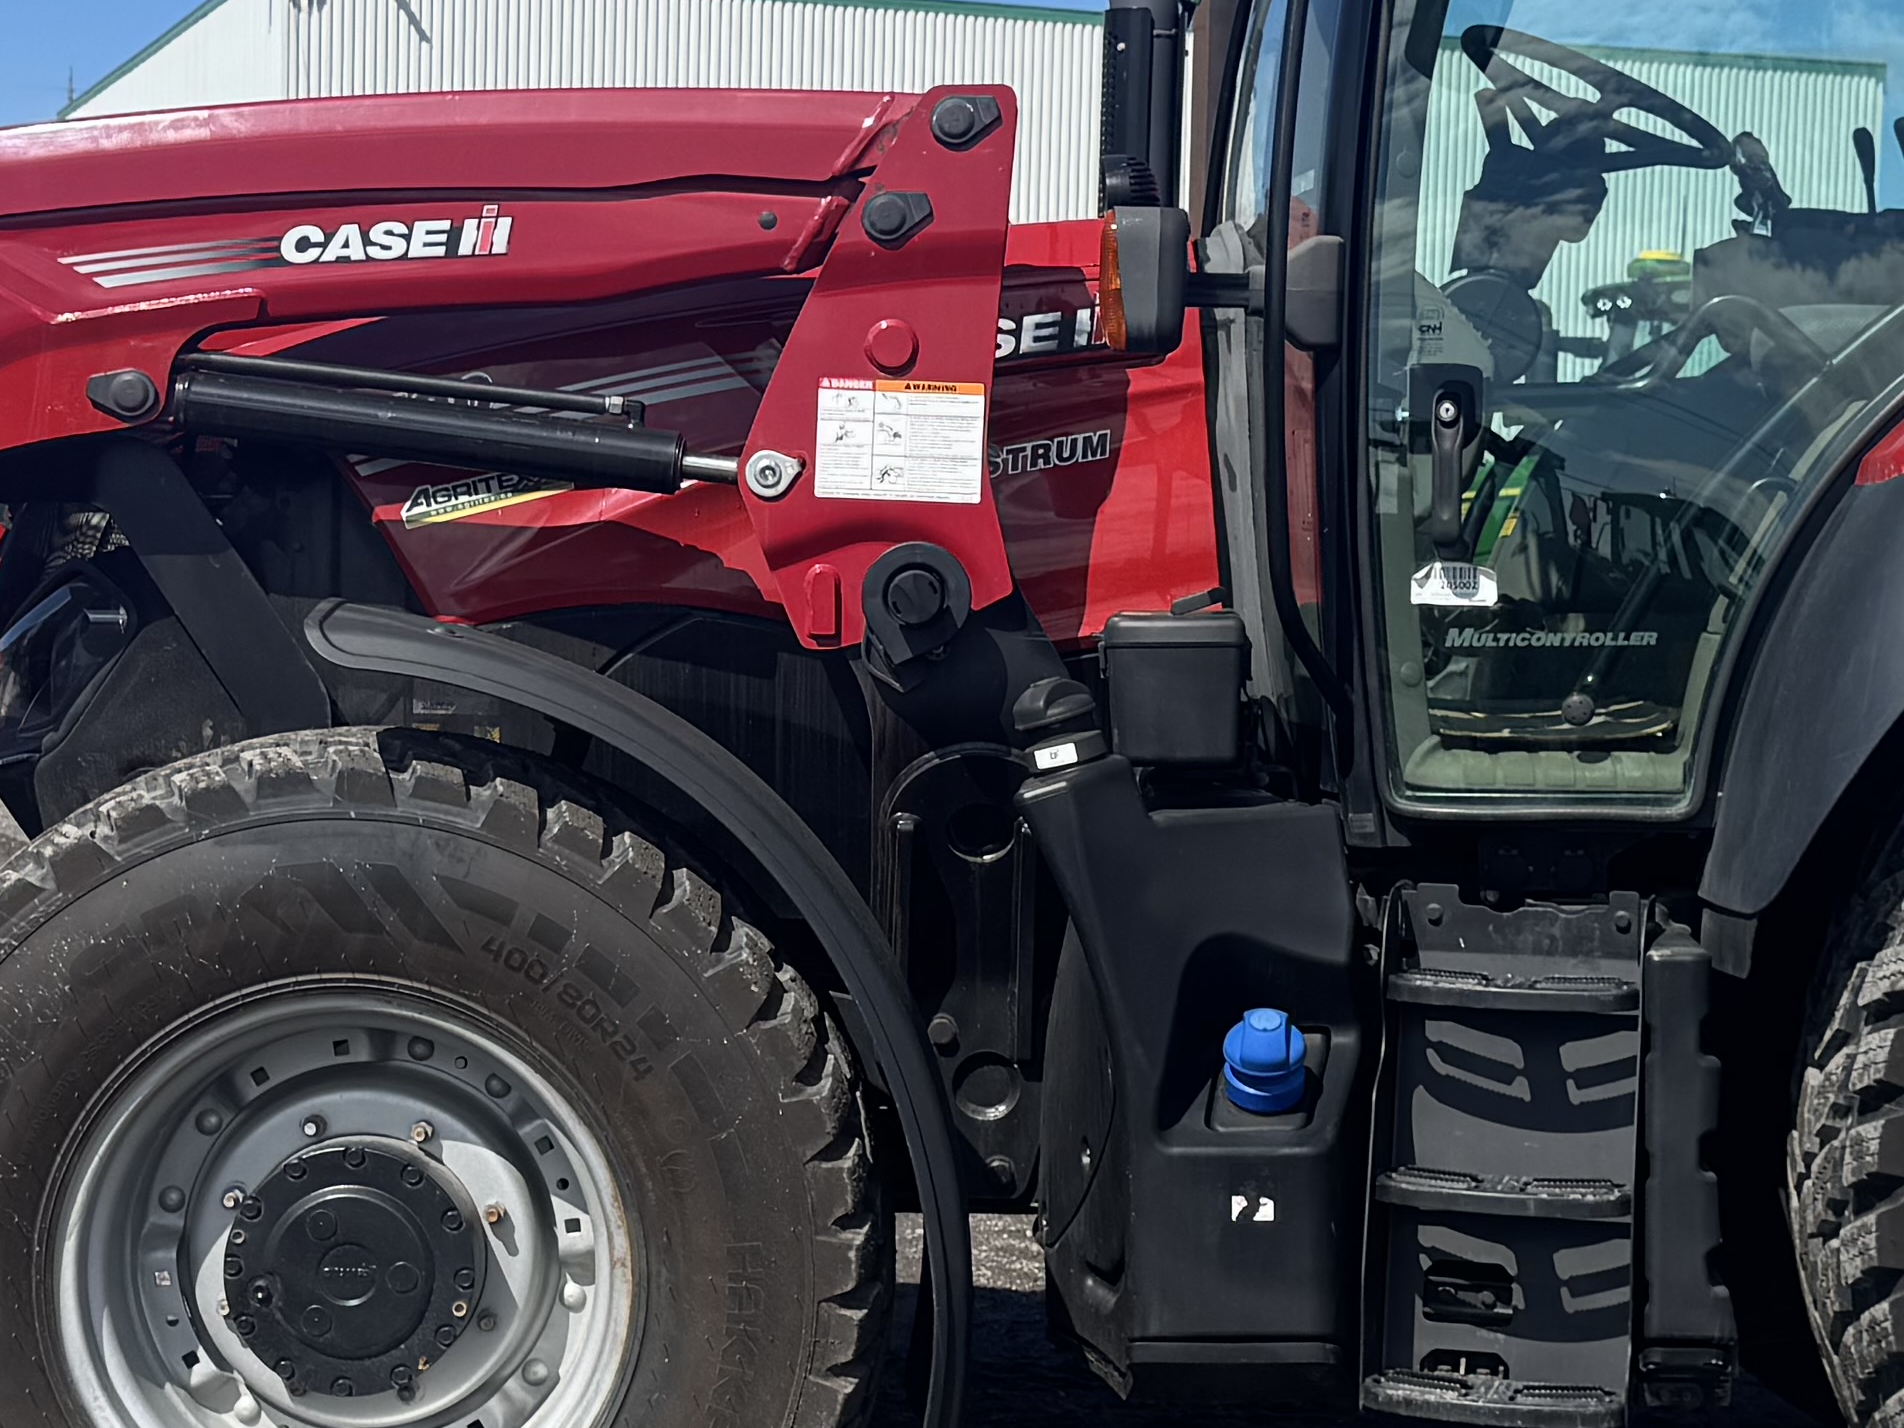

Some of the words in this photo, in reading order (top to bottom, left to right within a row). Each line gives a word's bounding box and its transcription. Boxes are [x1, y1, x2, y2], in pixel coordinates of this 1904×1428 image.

[280, 218, 452, 264] CASE
[994, 311, 1062, 358] SE
[989, 429, 1111, 478] STRUM
[480, 934, 655, 1083] 400/80R24
